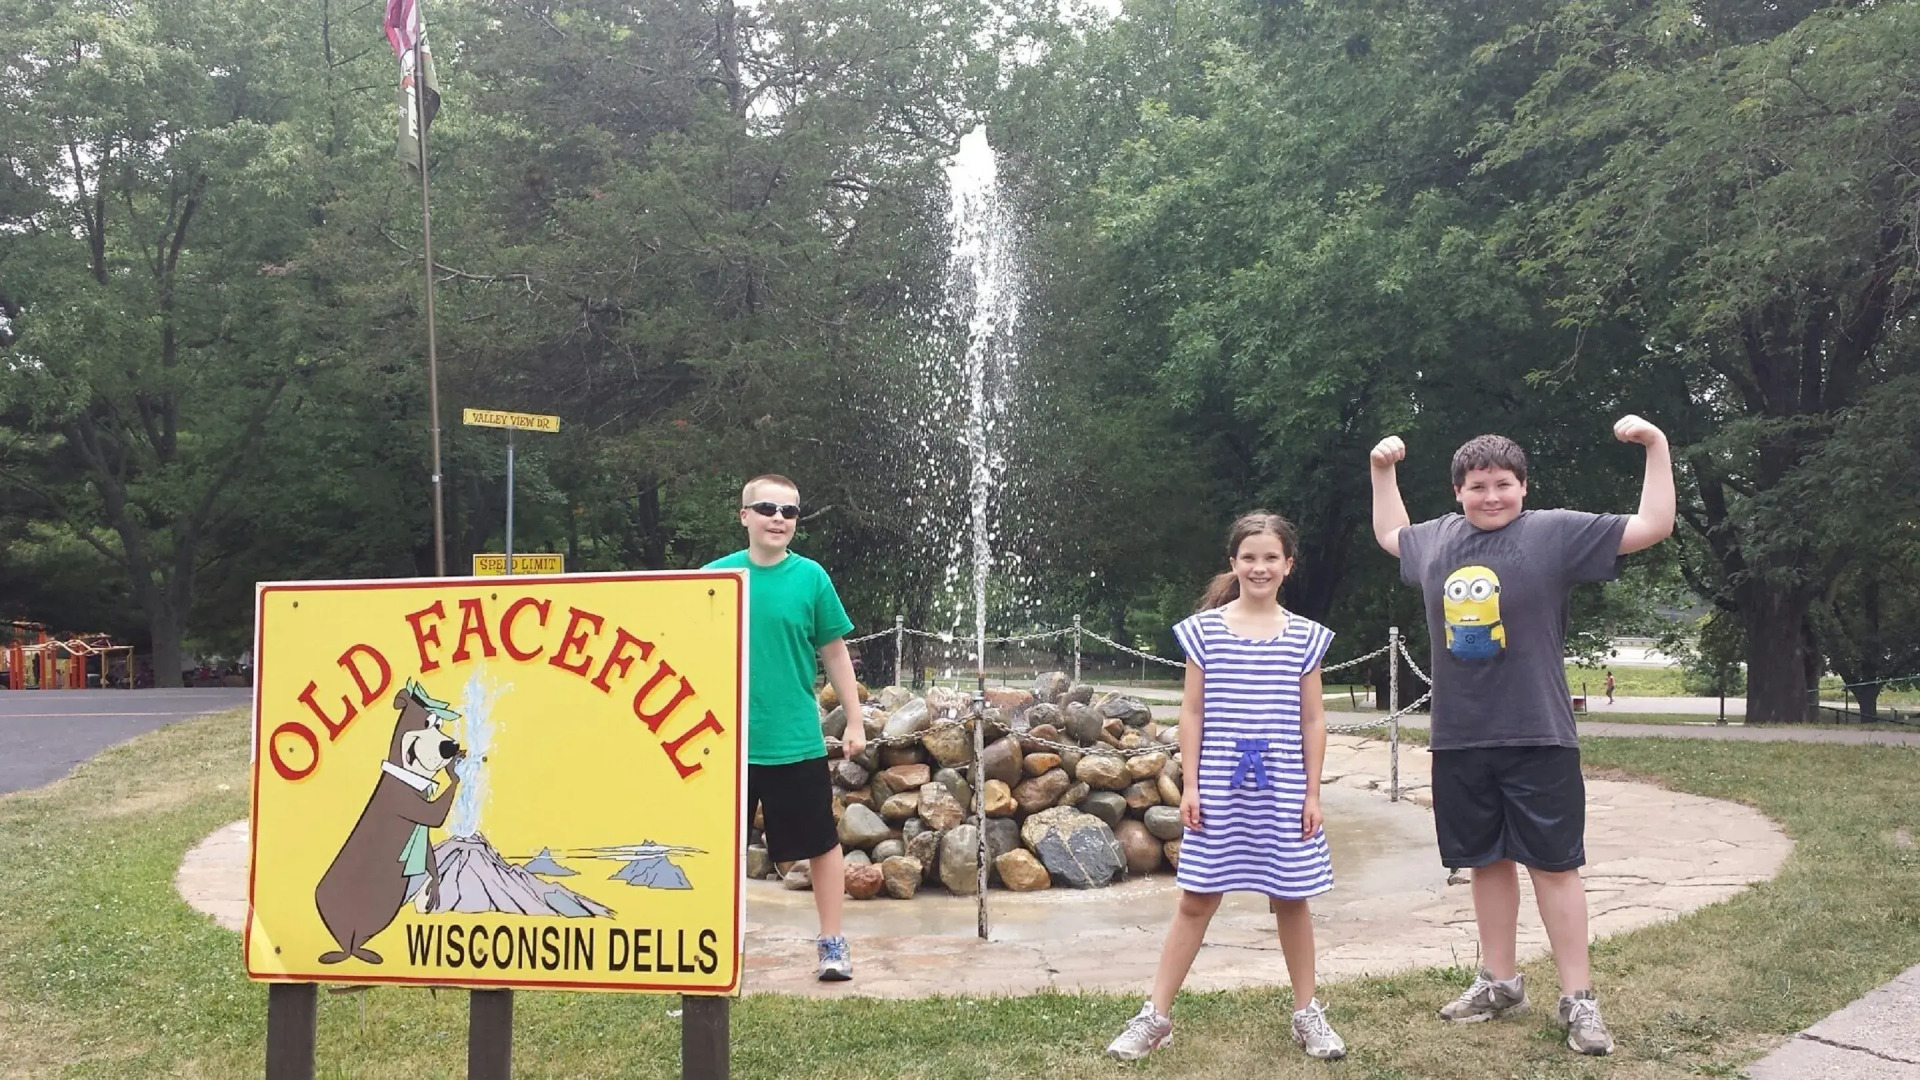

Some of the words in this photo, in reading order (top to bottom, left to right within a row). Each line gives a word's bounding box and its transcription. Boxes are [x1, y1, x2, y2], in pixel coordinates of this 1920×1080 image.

[472, 412, 507, 425] VALLEY
[510, 415, 535, 427] VIEW
[537, 418, 550, 429] DR
[521, 558, 556, 570] LIMIT
[269, 642, 393, 782] OLD
[405, 596, 726, 780] FACEFUL
[406, 924, 594, 970] WISCONSIN
[608, 928, 719, 975] DELLS
